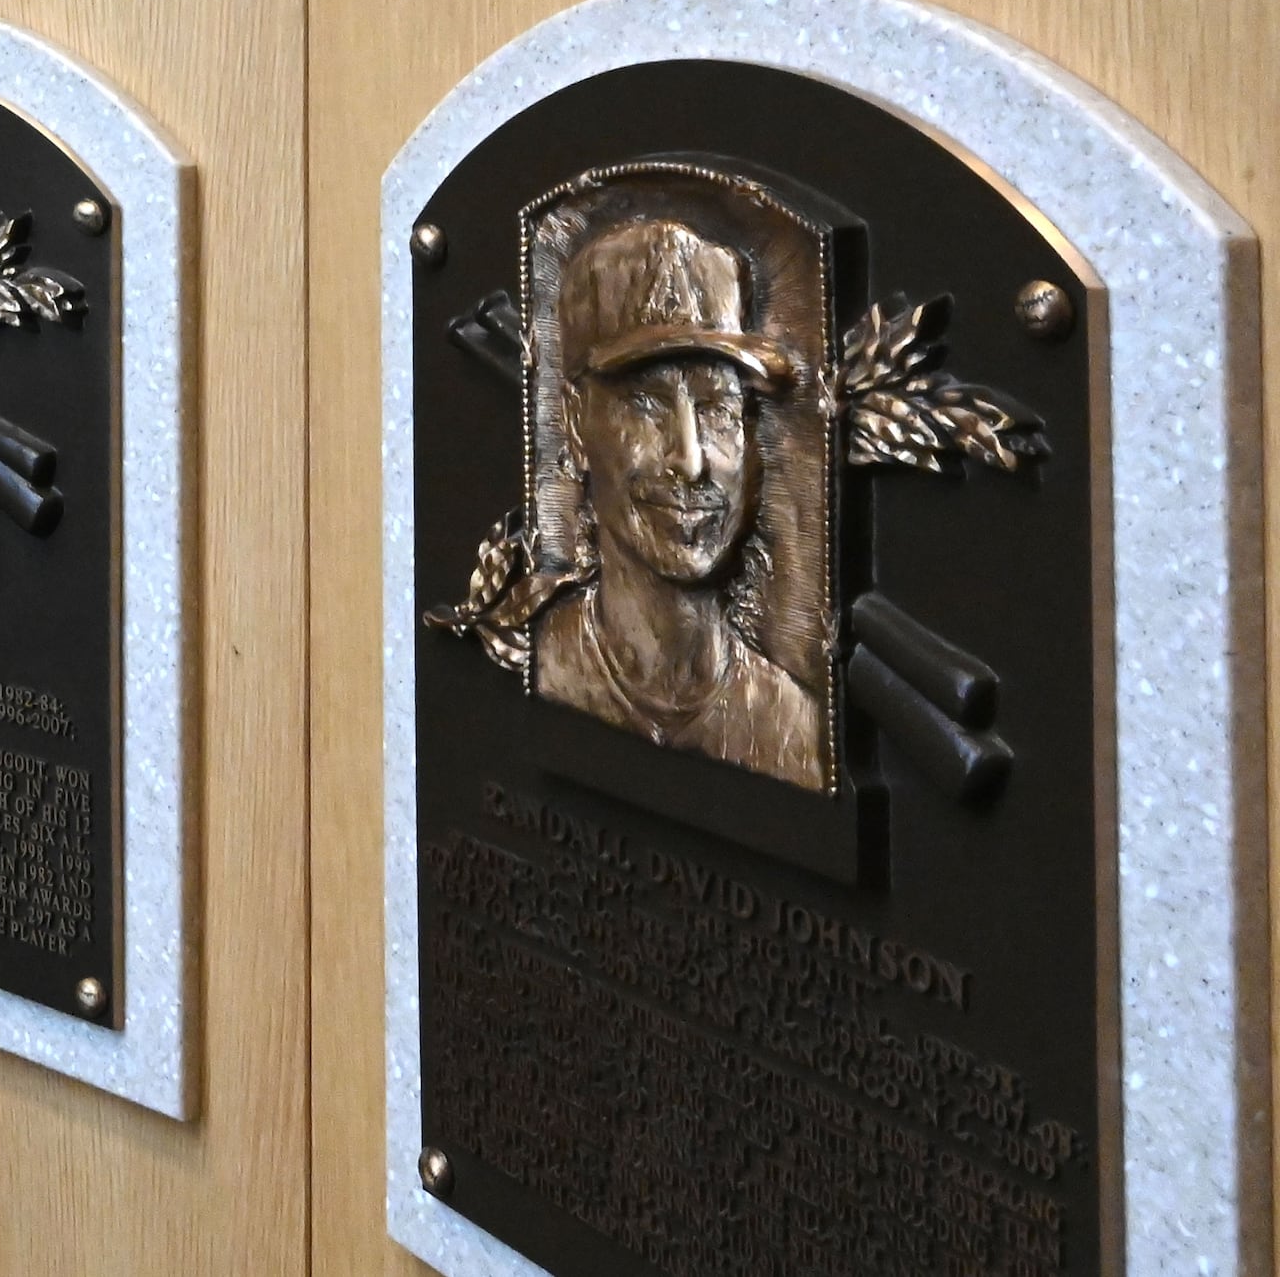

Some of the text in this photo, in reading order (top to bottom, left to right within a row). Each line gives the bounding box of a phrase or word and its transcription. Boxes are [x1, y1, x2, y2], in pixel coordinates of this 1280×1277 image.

[26, 778, 42, 800] IN
[55, 786, 90, 814] FIVE
[56, 764, 89, 792] WON
[15, 795, 34, 818] OF
[42, 803, 66, 828] HIS
[76, 813, 90, 835] 12
[31, 821, 55, 846] SIX
[0, 853, 15, 876] IN
[23, 860, 53, 889] 1982
[58, 872, 91, 901] AND
[59, 851, 90, 879] 1999
[32, 885, 91, 922] AWARDS
[60, 915, 76, 940] AS
[648, 850, 760, 921] DAVID
[773, 899, 976, 1013] JOHNSON
